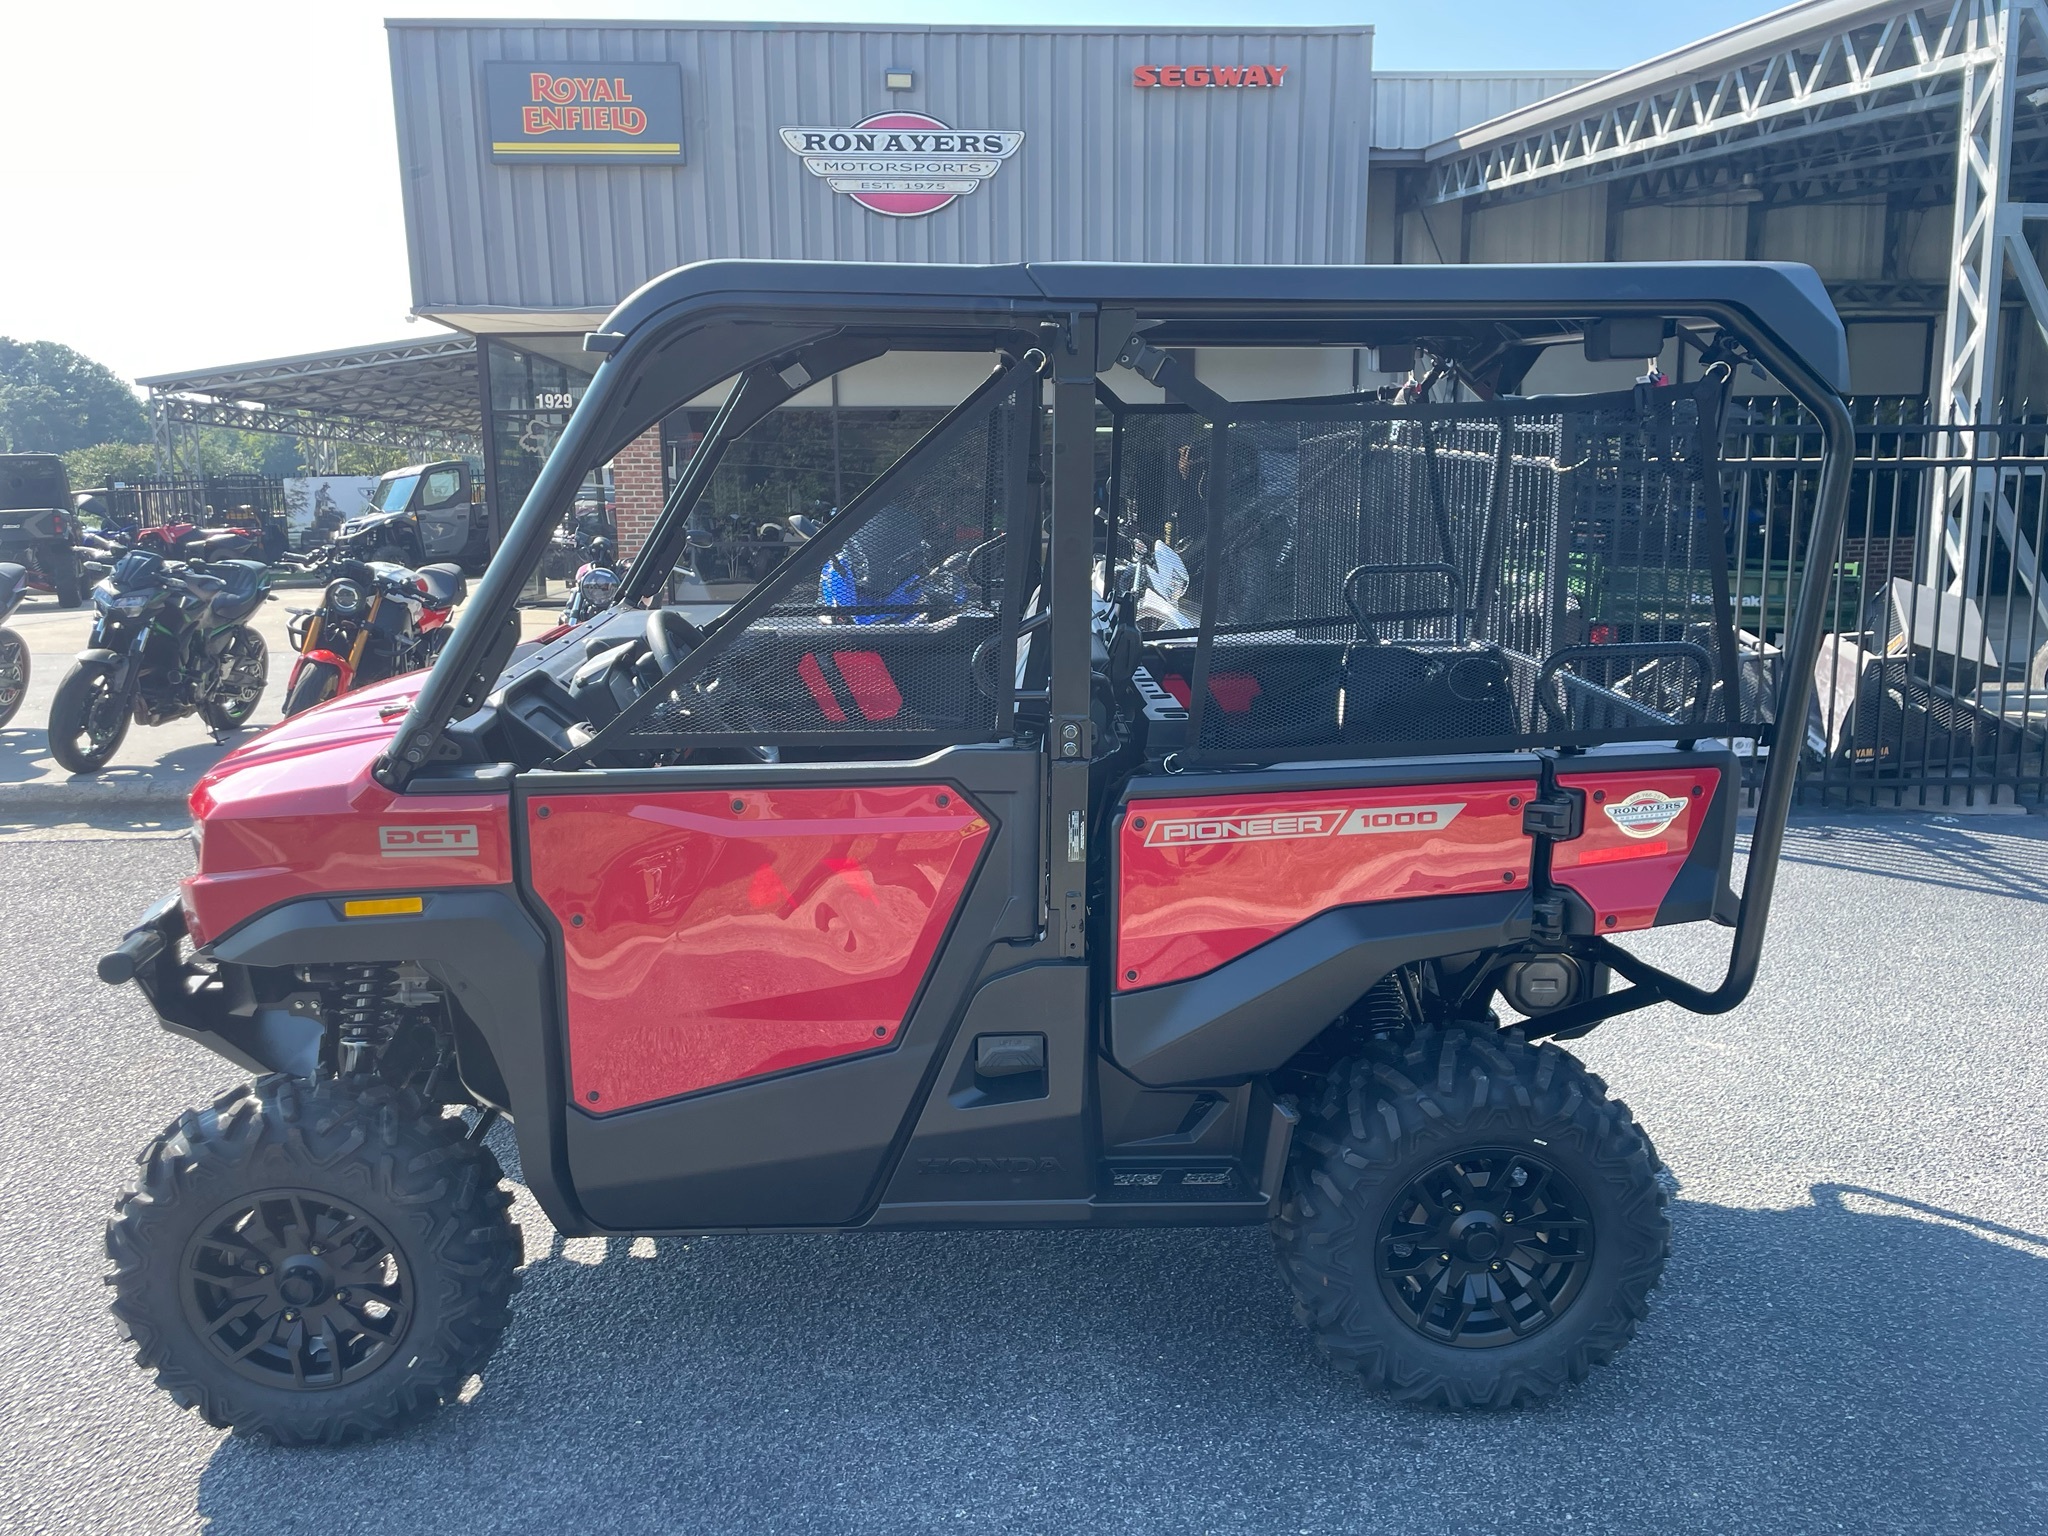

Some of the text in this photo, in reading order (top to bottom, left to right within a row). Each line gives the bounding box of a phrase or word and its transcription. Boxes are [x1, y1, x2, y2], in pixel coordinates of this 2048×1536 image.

[1133, 64, 1288, 87] SEGWAY
[530, 72, 633, 105] ROYAL
[522, 106, 647, 136] ENFIELD
[802, 133, 1004, 153] RON AYERS
[824, 162, 981, 173] MOTORSPORTS
[861, 182, 946, 190] EST. 1975
[536, 393, 573, 409] 1929
[1855, 746, 1889, 758] YAMA
[1613, 803, 1681, 814] RON AYERS
[1163, 811, 1438, 841] PIONEER 1000
[386, 829, 471, 844] DCT
[917, 1156, 1068, 1175] HONDA
